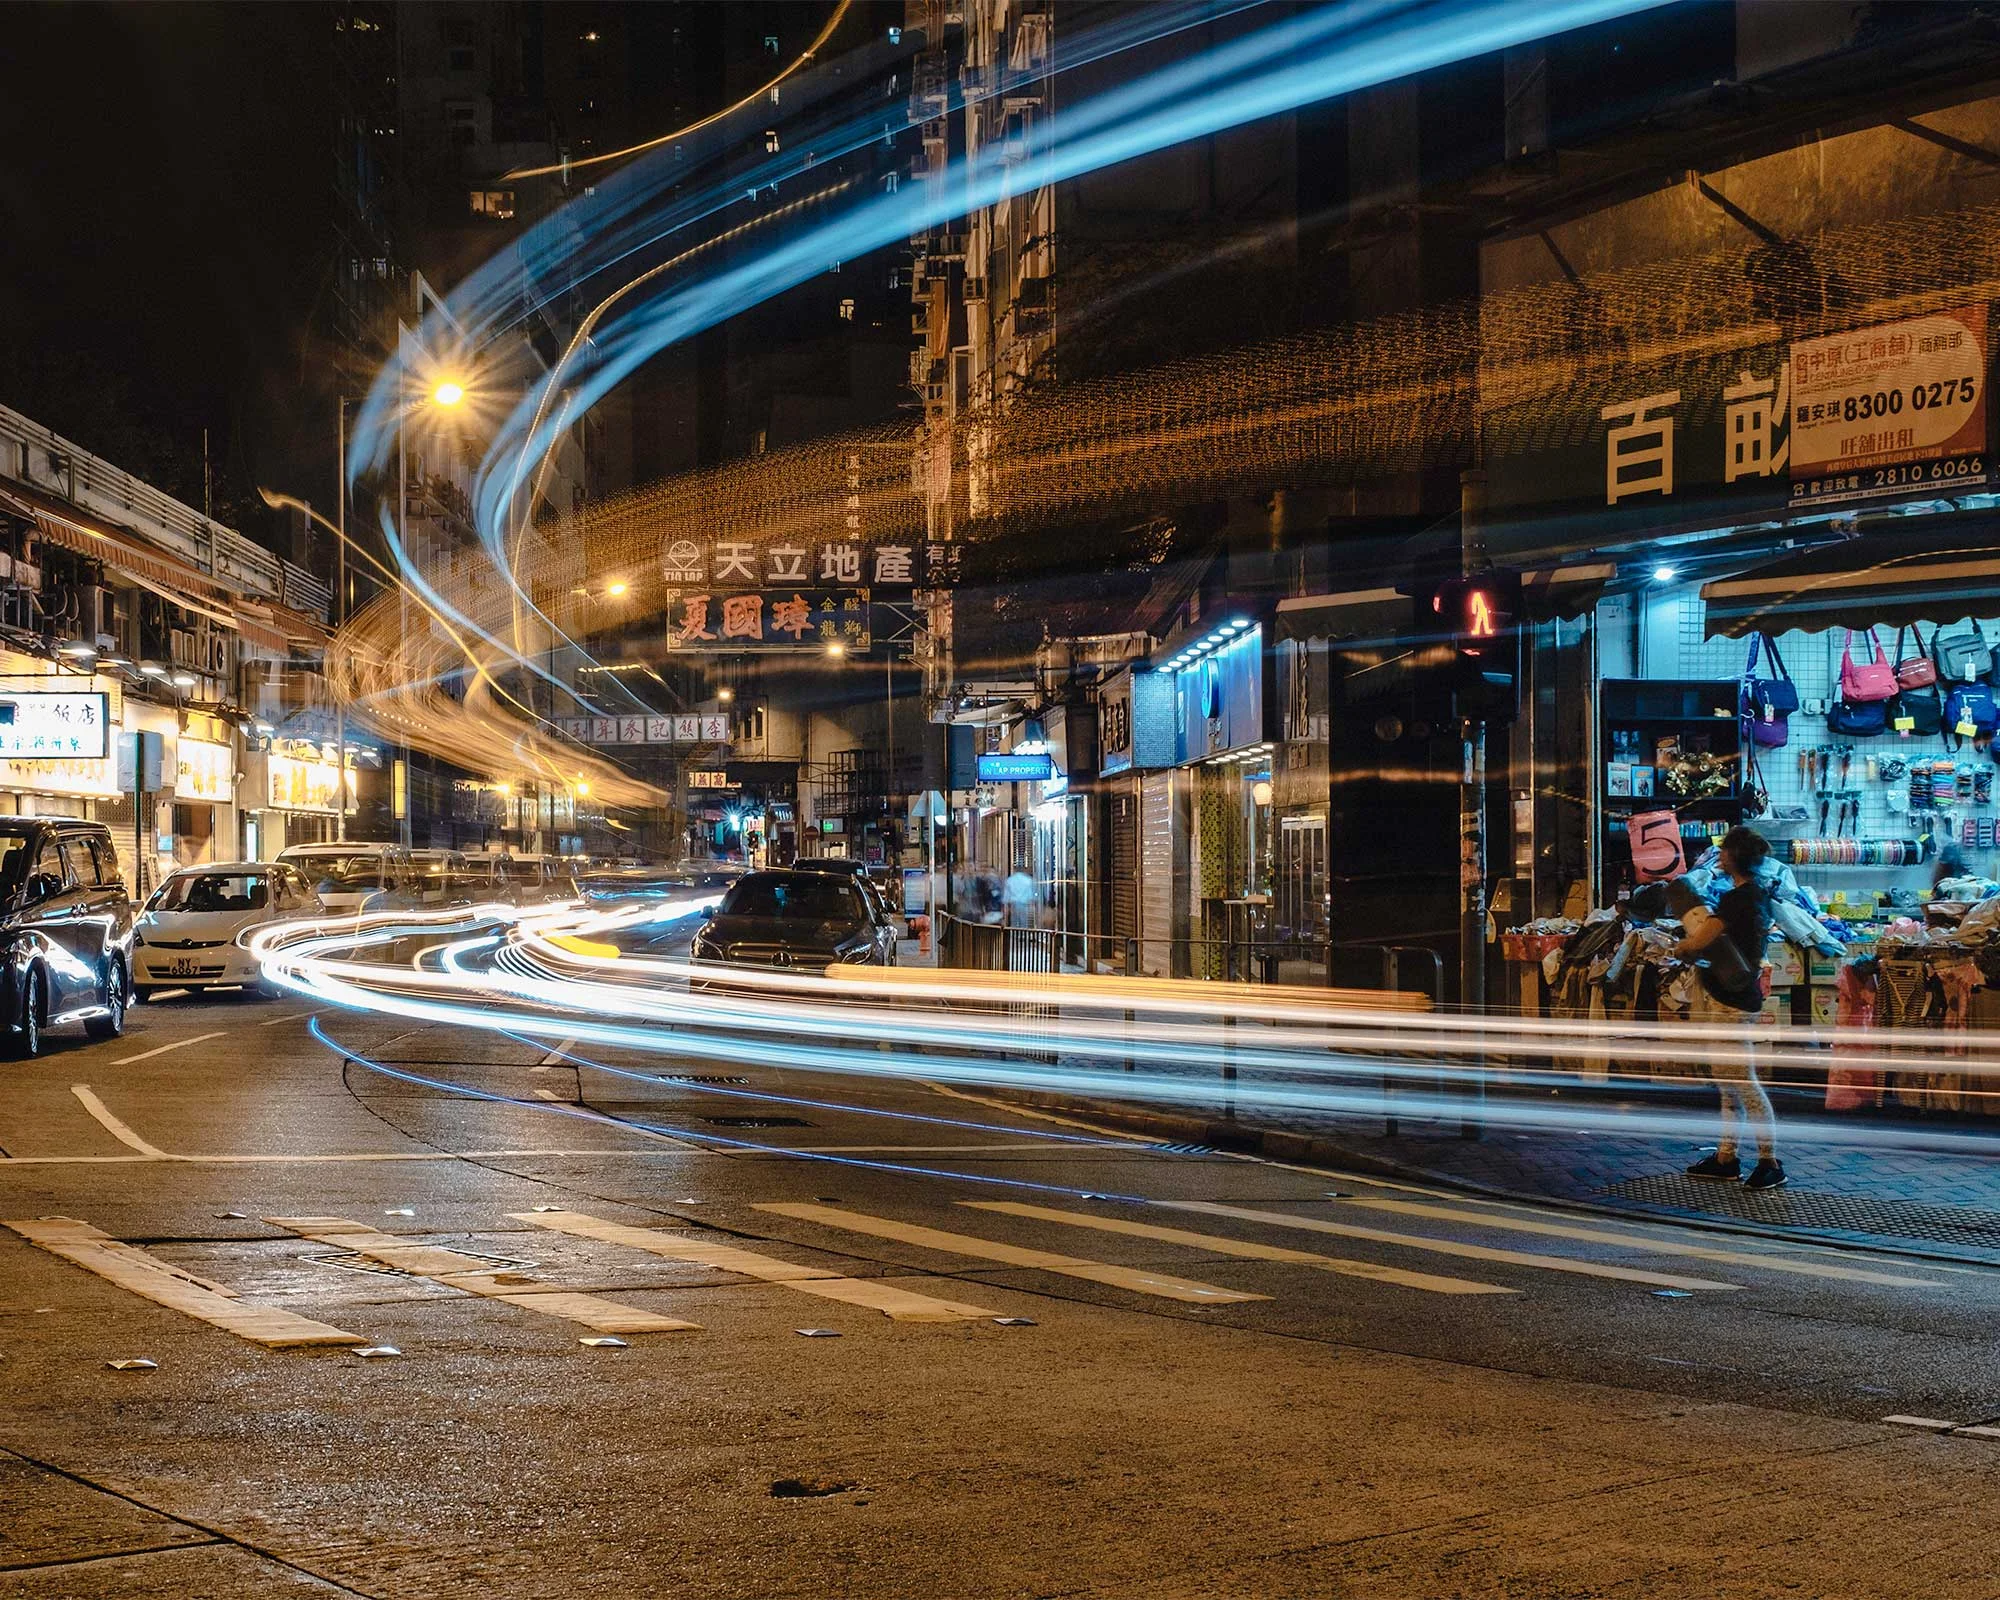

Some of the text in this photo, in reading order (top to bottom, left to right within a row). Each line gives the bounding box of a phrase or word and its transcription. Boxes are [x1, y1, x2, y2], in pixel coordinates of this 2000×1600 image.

[1844, 389, 1903, 421] 8300
[1912, 376, 1975, 411] 0275
[1874, 465, 1923, 486] 2810
[1931, 457, 1983, 479] 6066
[715, 542, 913, 583] 天立地產
[675, 593, 815, 640] 夏國璋
[1010, 766, 1050, 775] PROPERTY
[1641, 817, 1681, 876] 5
[178, 958, 192, 967] NY
